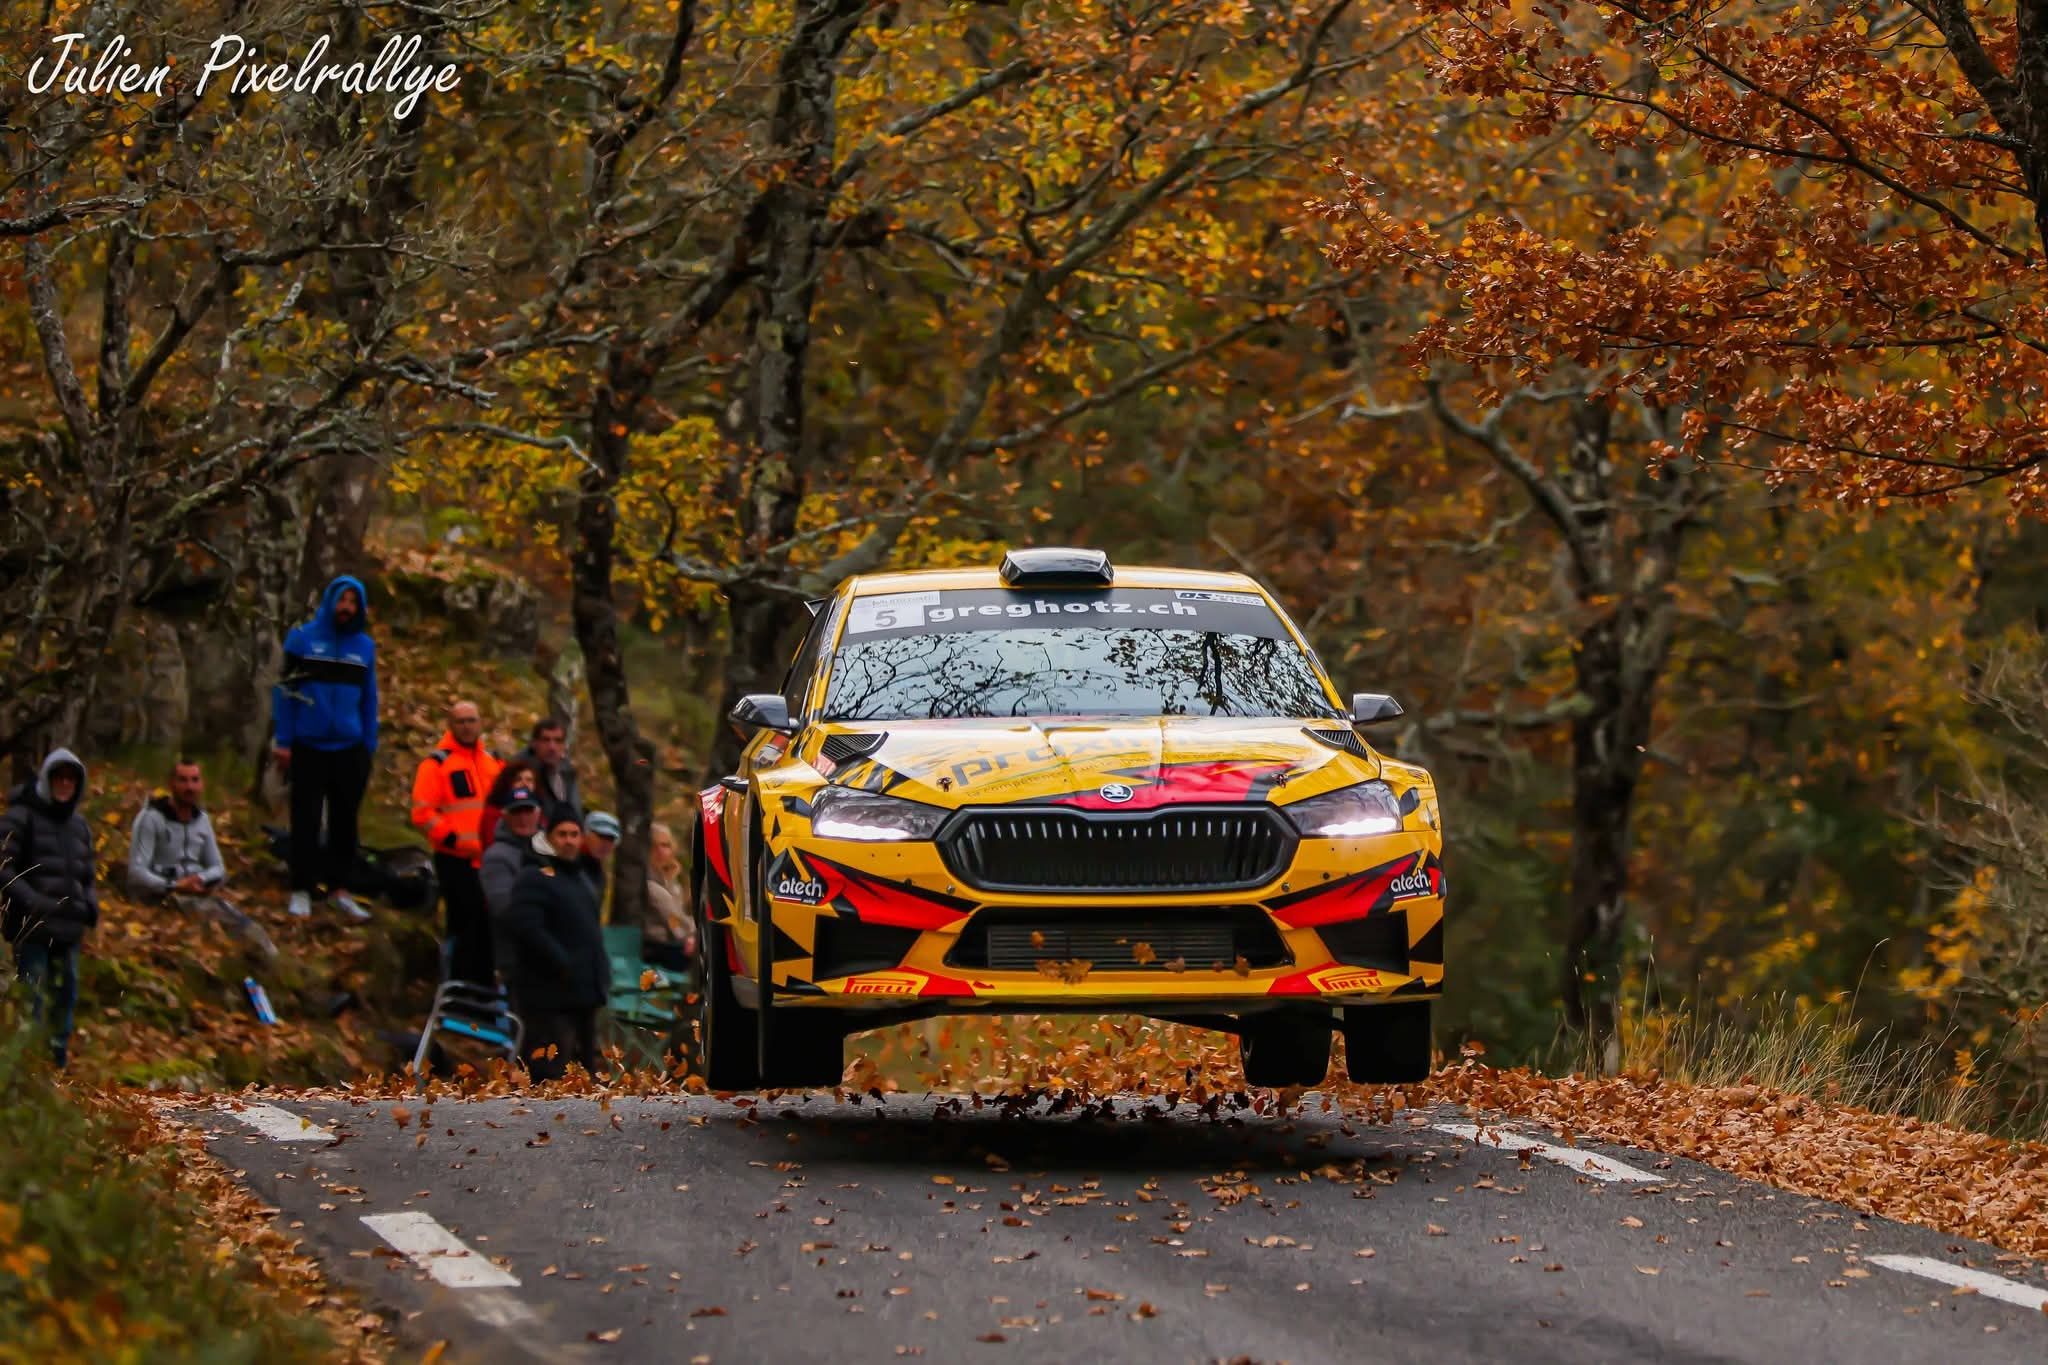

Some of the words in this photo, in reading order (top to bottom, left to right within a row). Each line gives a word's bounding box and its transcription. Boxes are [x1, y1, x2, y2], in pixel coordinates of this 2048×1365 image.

[875, 609, 898, 628] 5
[928, 599, 1198, 622] greghotz.ch
[843, 977, 918, 994] PIRELLI
[1318, 969, 1383, 992] PIRELLI
